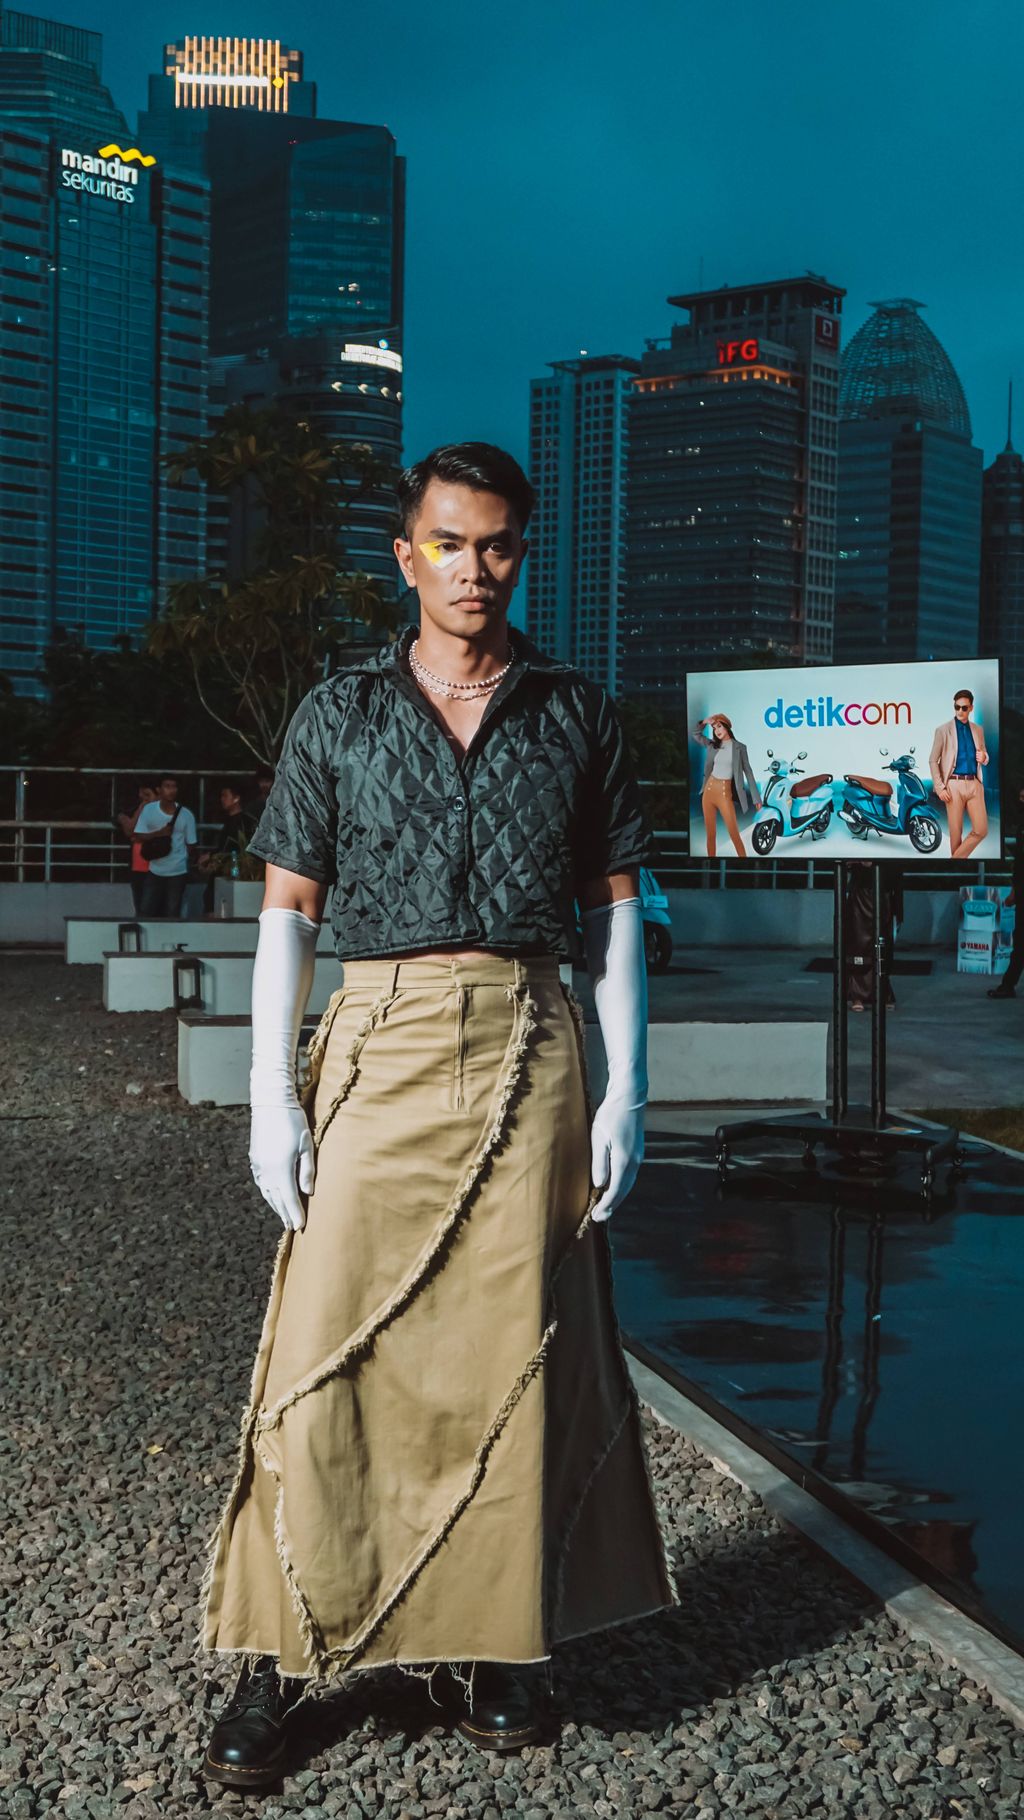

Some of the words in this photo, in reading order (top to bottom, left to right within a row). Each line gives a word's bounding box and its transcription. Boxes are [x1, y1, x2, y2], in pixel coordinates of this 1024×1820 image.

[61, 148, 138, 185] mandiri
[62, 170, 135, 204] sekuritas
[764, 696, 912, 729] detikcom
[966, 942, 990, 952] YAMAHA
